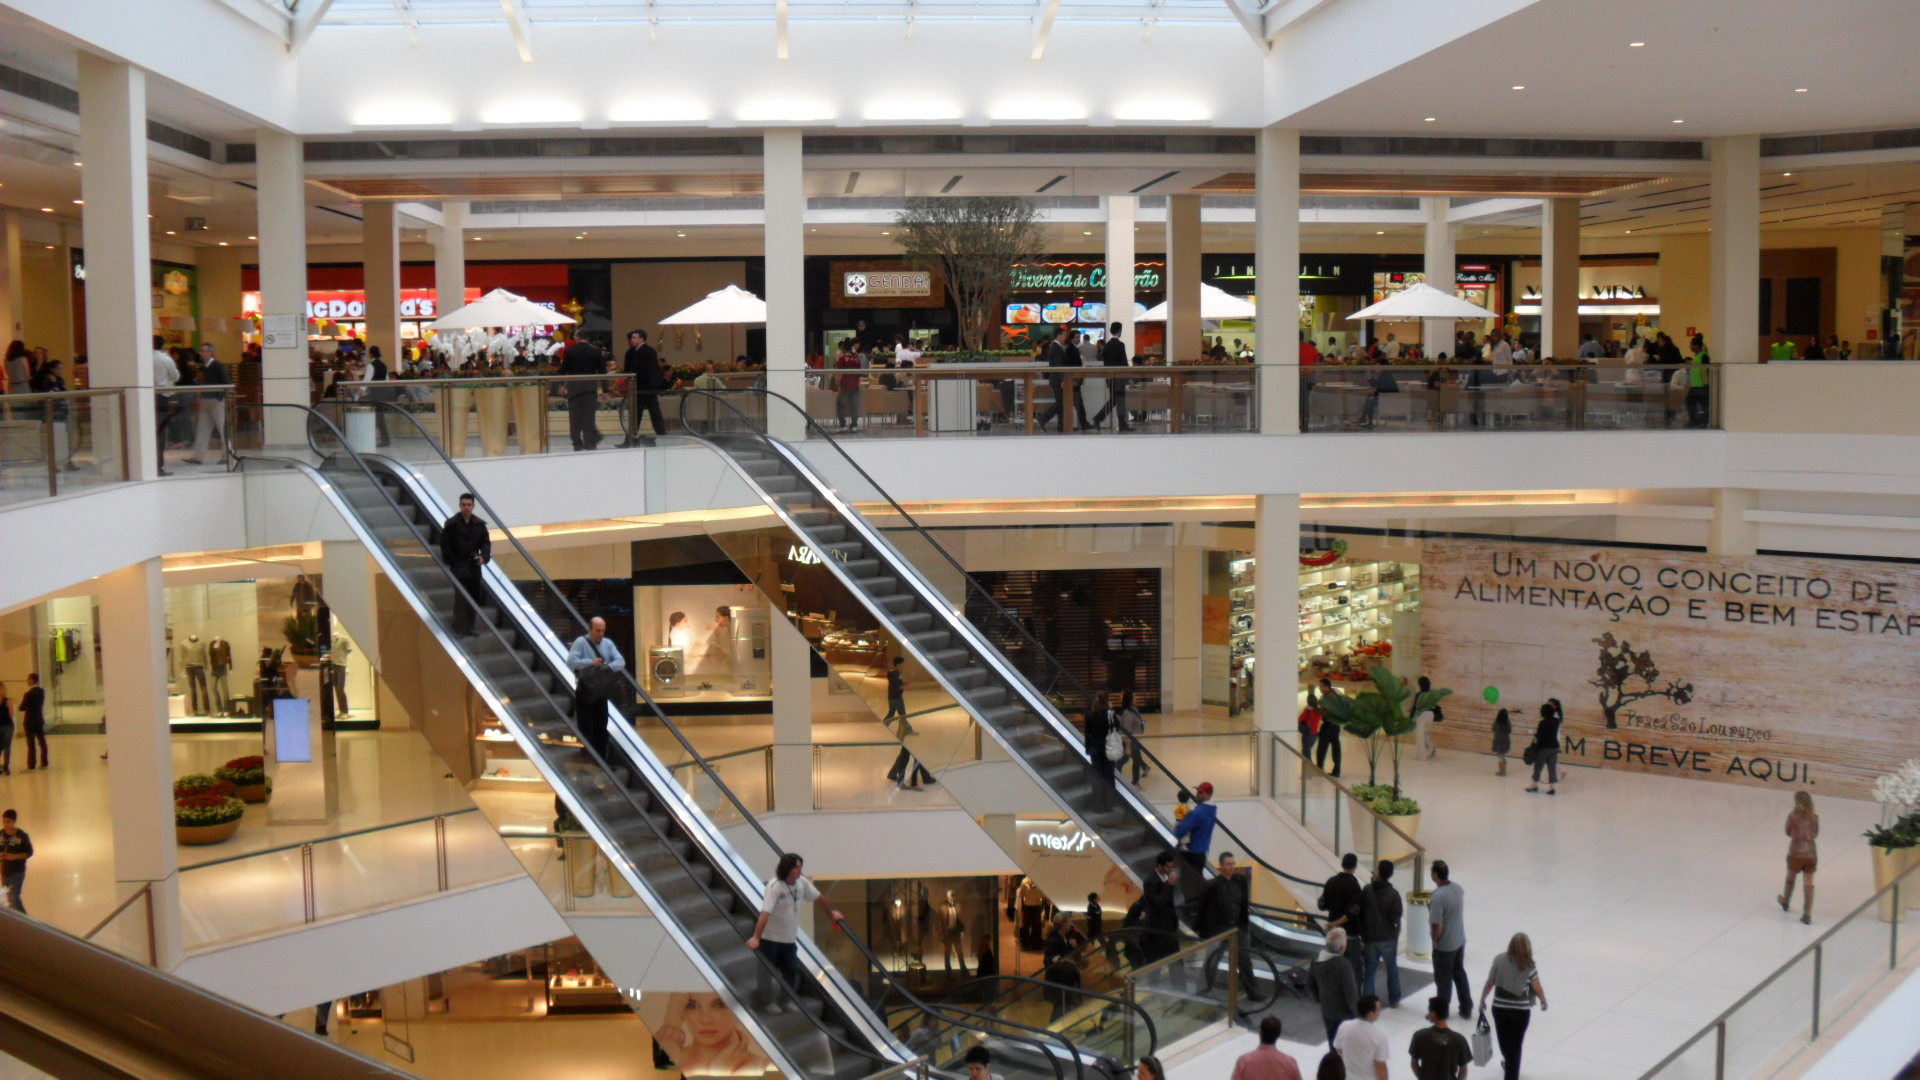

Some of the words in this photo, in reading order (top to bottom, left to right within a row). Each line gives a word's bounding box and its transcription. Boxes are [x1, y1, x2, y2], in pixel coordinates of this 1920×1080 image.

[1074, 274, 1087, 287] do
[1214, 265, 1254, 276] JIN
[1301, 265, 1340, 276] JIN
[1592, 284, 1647, 298] VIENA
[1493, 552, 1536, 578] UM
[1553, 561, 1641, 586] NOVO
[1657, 567, 1832, 600] CONCEITO
[1851, 581, 1898, 604] DE
[1454, 576, 1671, 622] ALIMENTAÇÃO
[1688, 598, 1707, 620] E
[1725, 601, 1796, 627] BEM
[1603, 740, 1712, 773] BREVE
[1726, 756, 1816, 785] AQUI.
